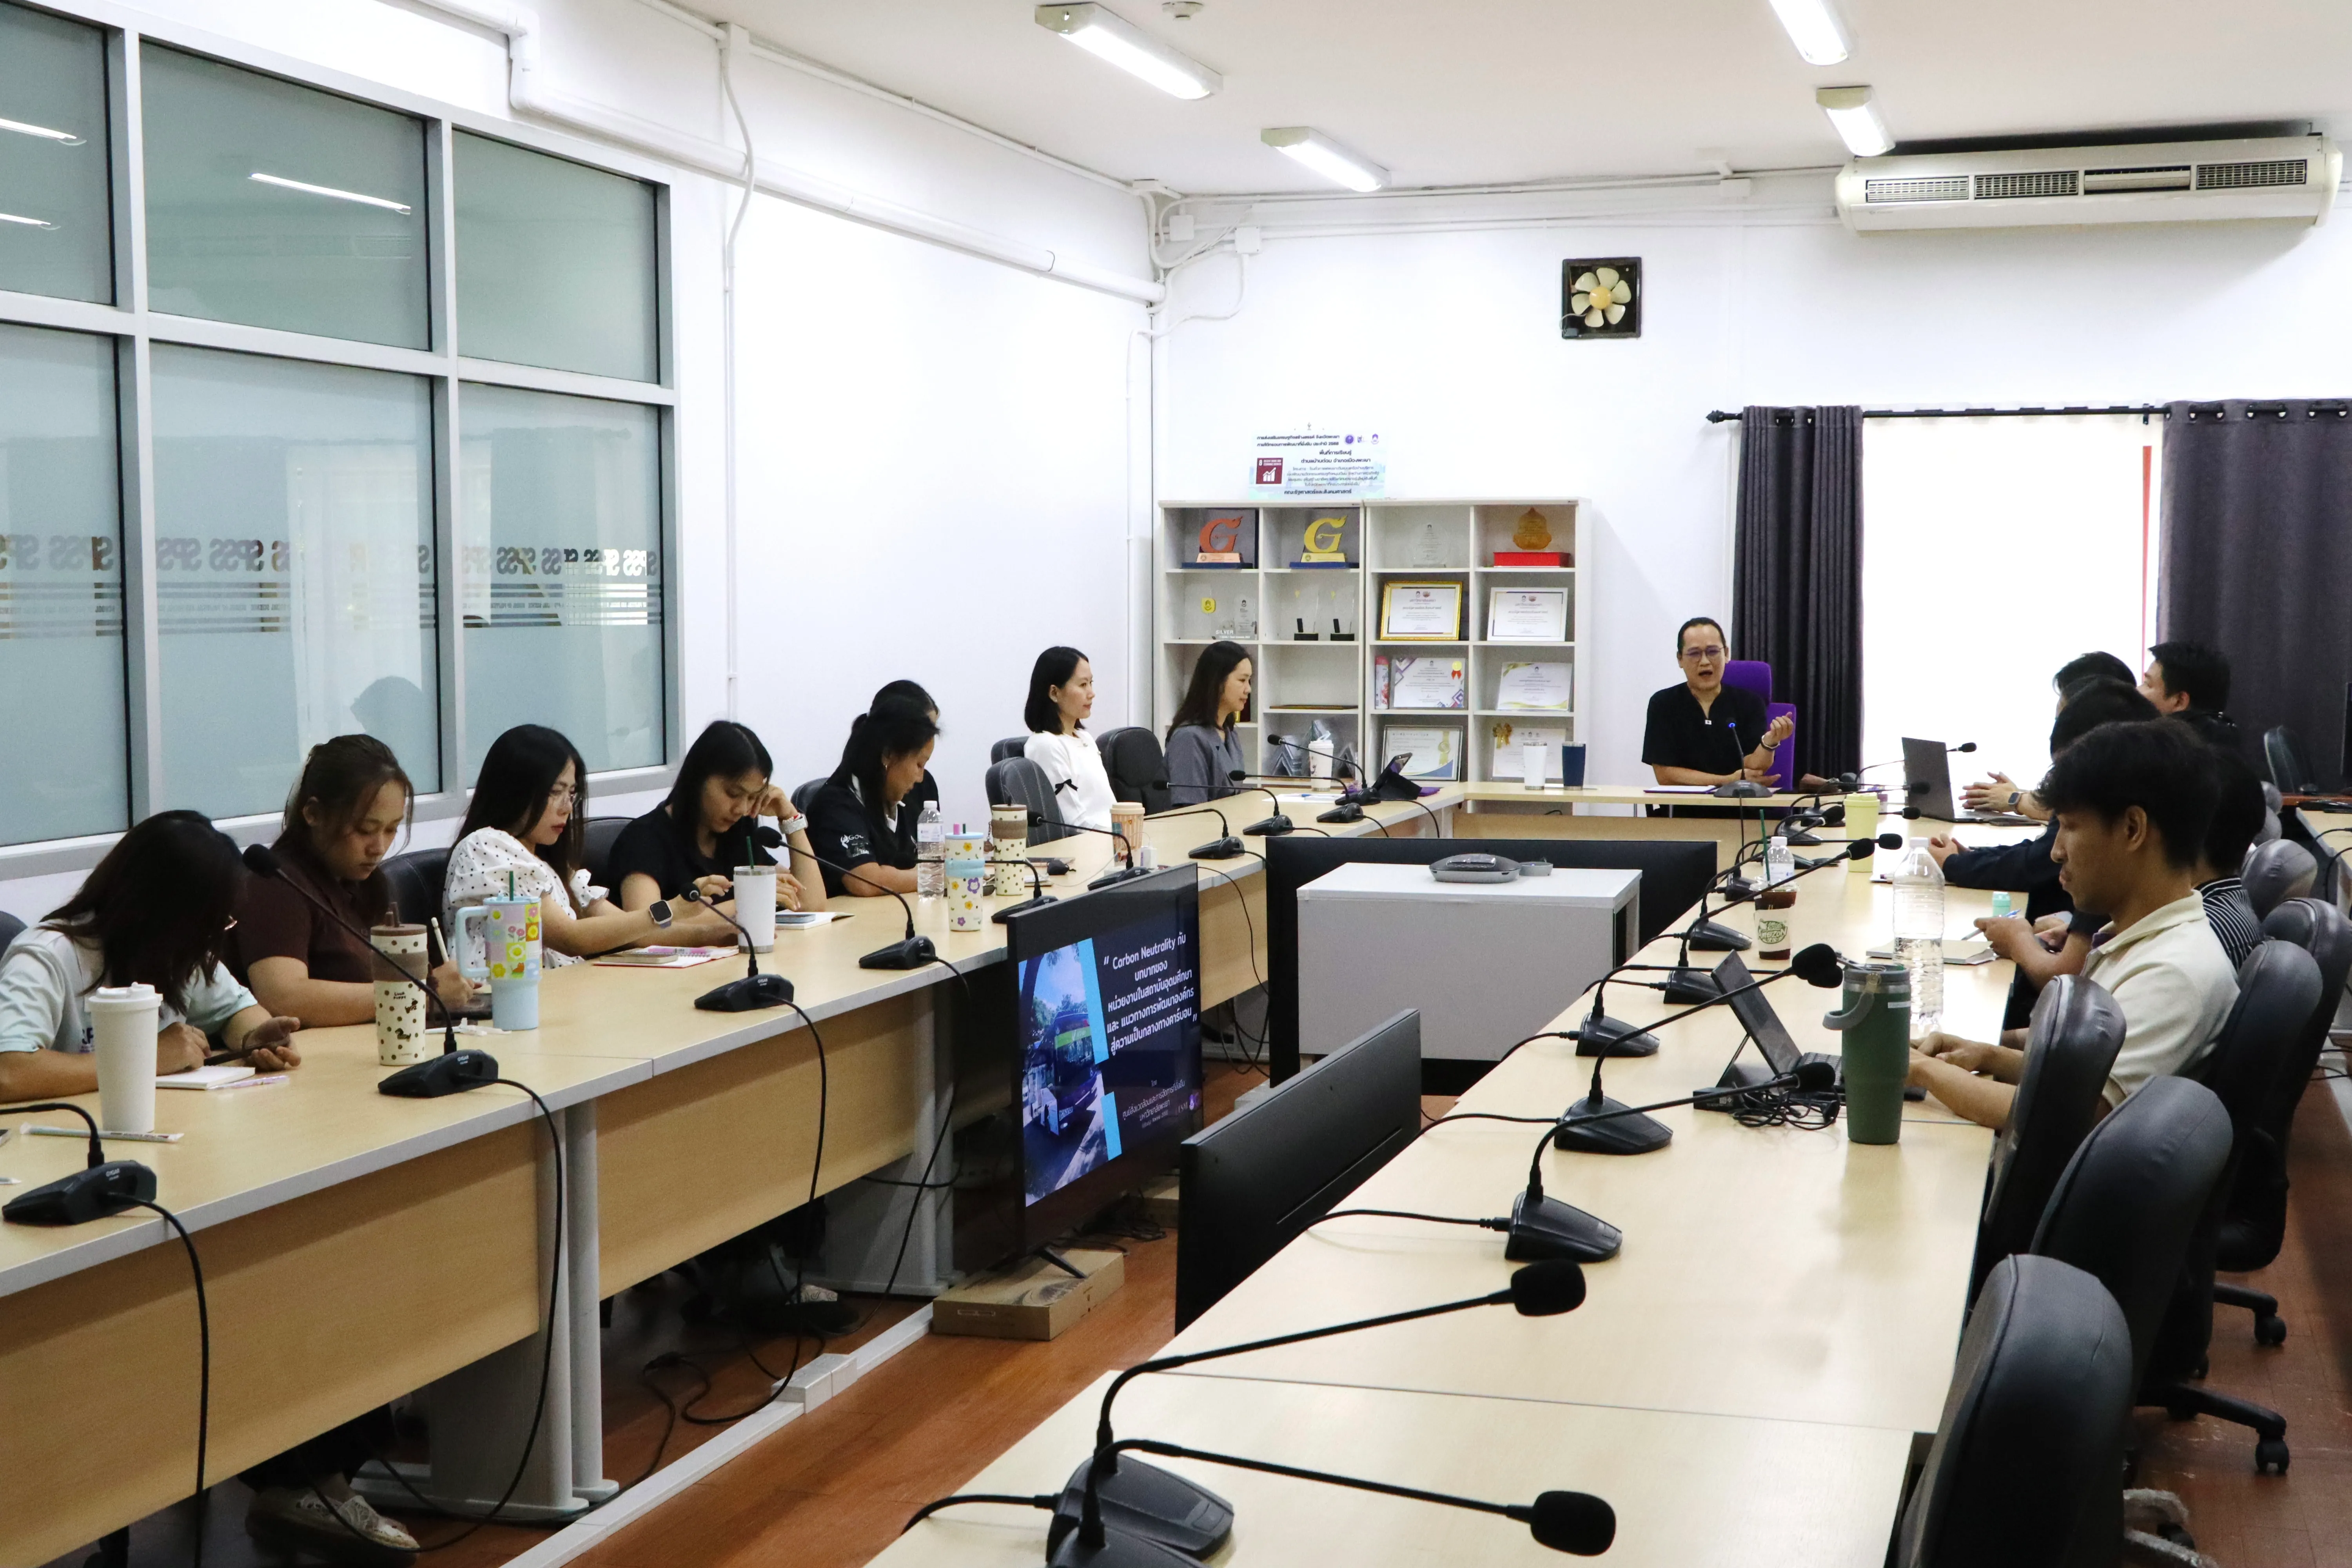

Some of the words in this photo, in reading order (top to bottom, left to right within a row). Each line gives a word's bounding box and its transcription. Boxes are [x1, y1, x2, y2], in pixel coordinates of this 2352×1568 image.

[1112, 953, 1139, 970] Carbon
[1141, 938, 1176, 959] Neutrality
[1178, 931, 1186, 946] กับ
[1134, 960, 1168, 982] บทบาทของ
[1107, 1021, 1119, 1034] และ
[1122, 986, 1194, 1027] แนวทางการพัฒนาองค์กร
[1108, 969, 1192, 1013] หน่วยงานในสถาบันอุดมศึกษา
[1111, 1007, 1192, 1056] สู่ความเป็นกลางทางคาร์บอน
